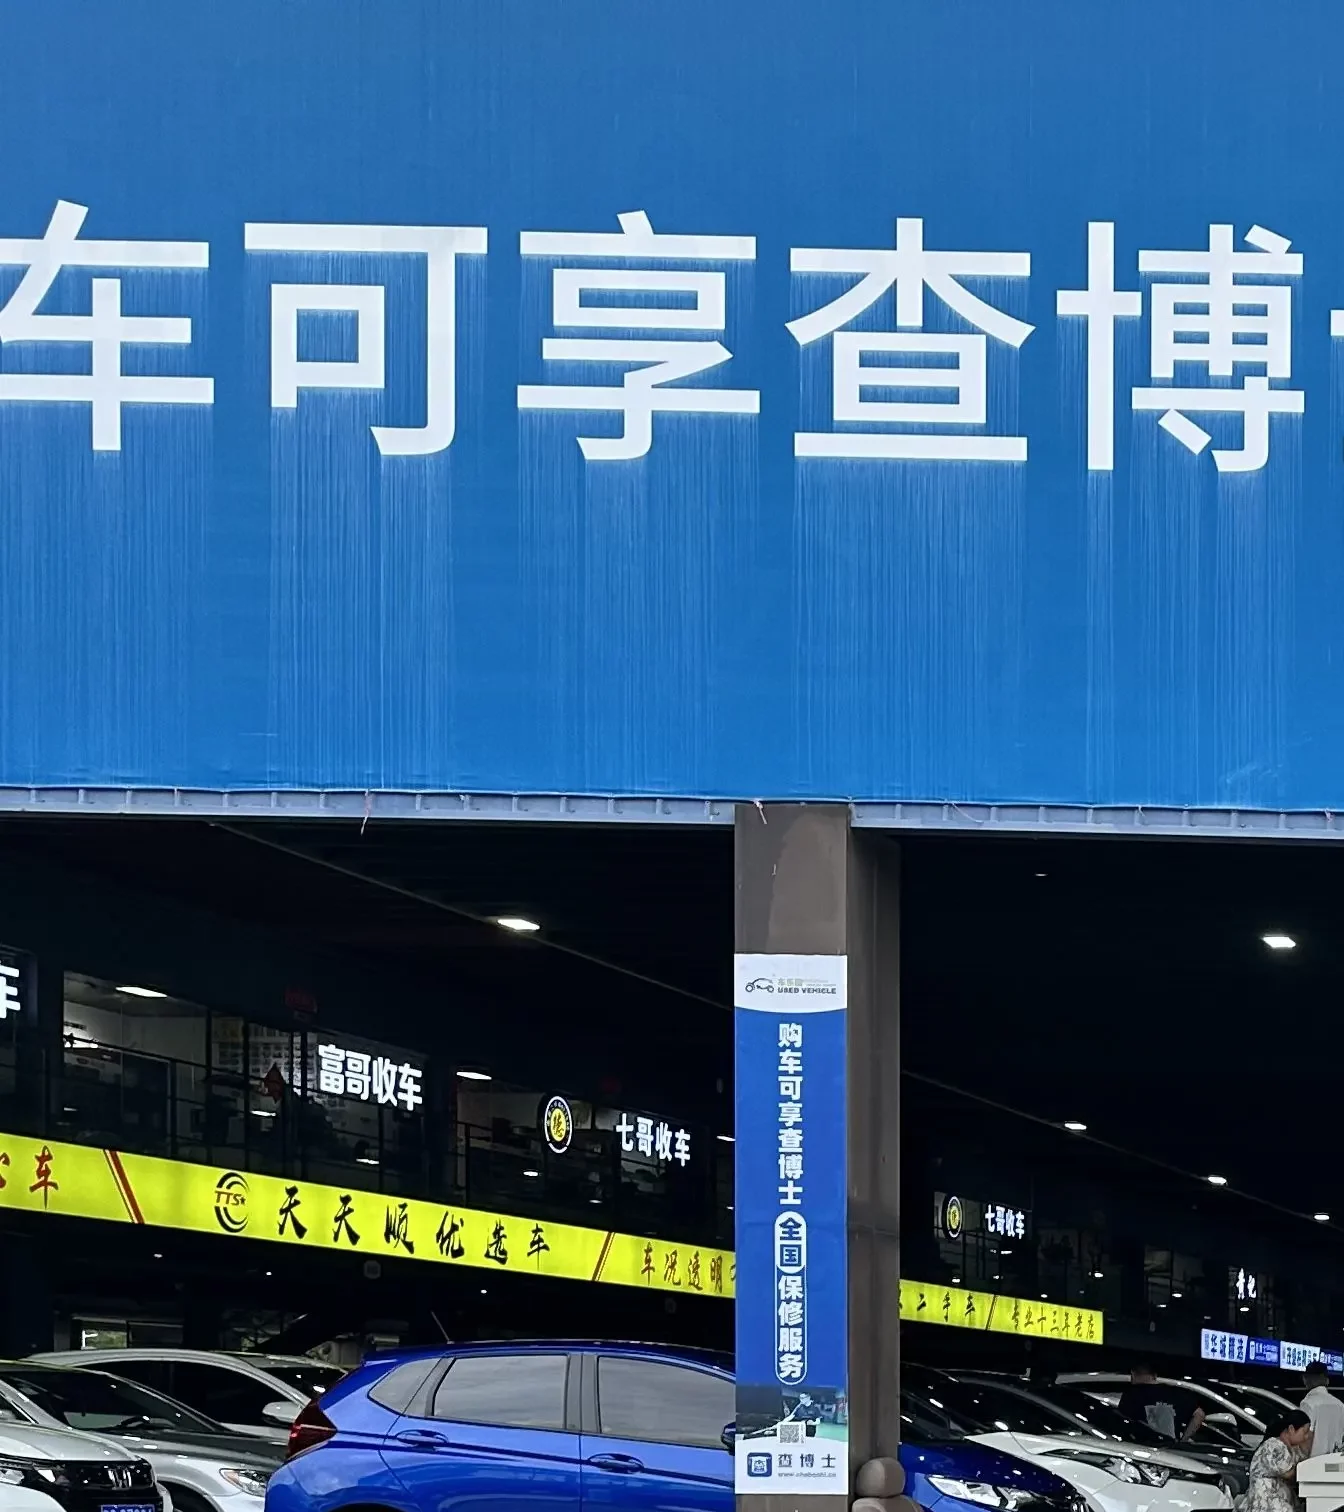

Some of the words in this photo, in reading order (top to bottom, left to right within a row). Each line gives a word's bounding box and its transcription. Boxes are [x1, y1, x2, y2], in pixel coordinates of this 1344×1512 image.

[318, 1044, 423, 1111] 富哥收车
[616, 1113, 691, 1167] 七哥收车
[777, 1023, 803, 1205] 购车可享查博士
[276, 1185, 551, 1269] 天天顺优选车
[640, 1242, 735, 1294] 车况透明
[899, 1286, 976, 1322] 二手车
[777, 1453, 836, 1468] 查博士
